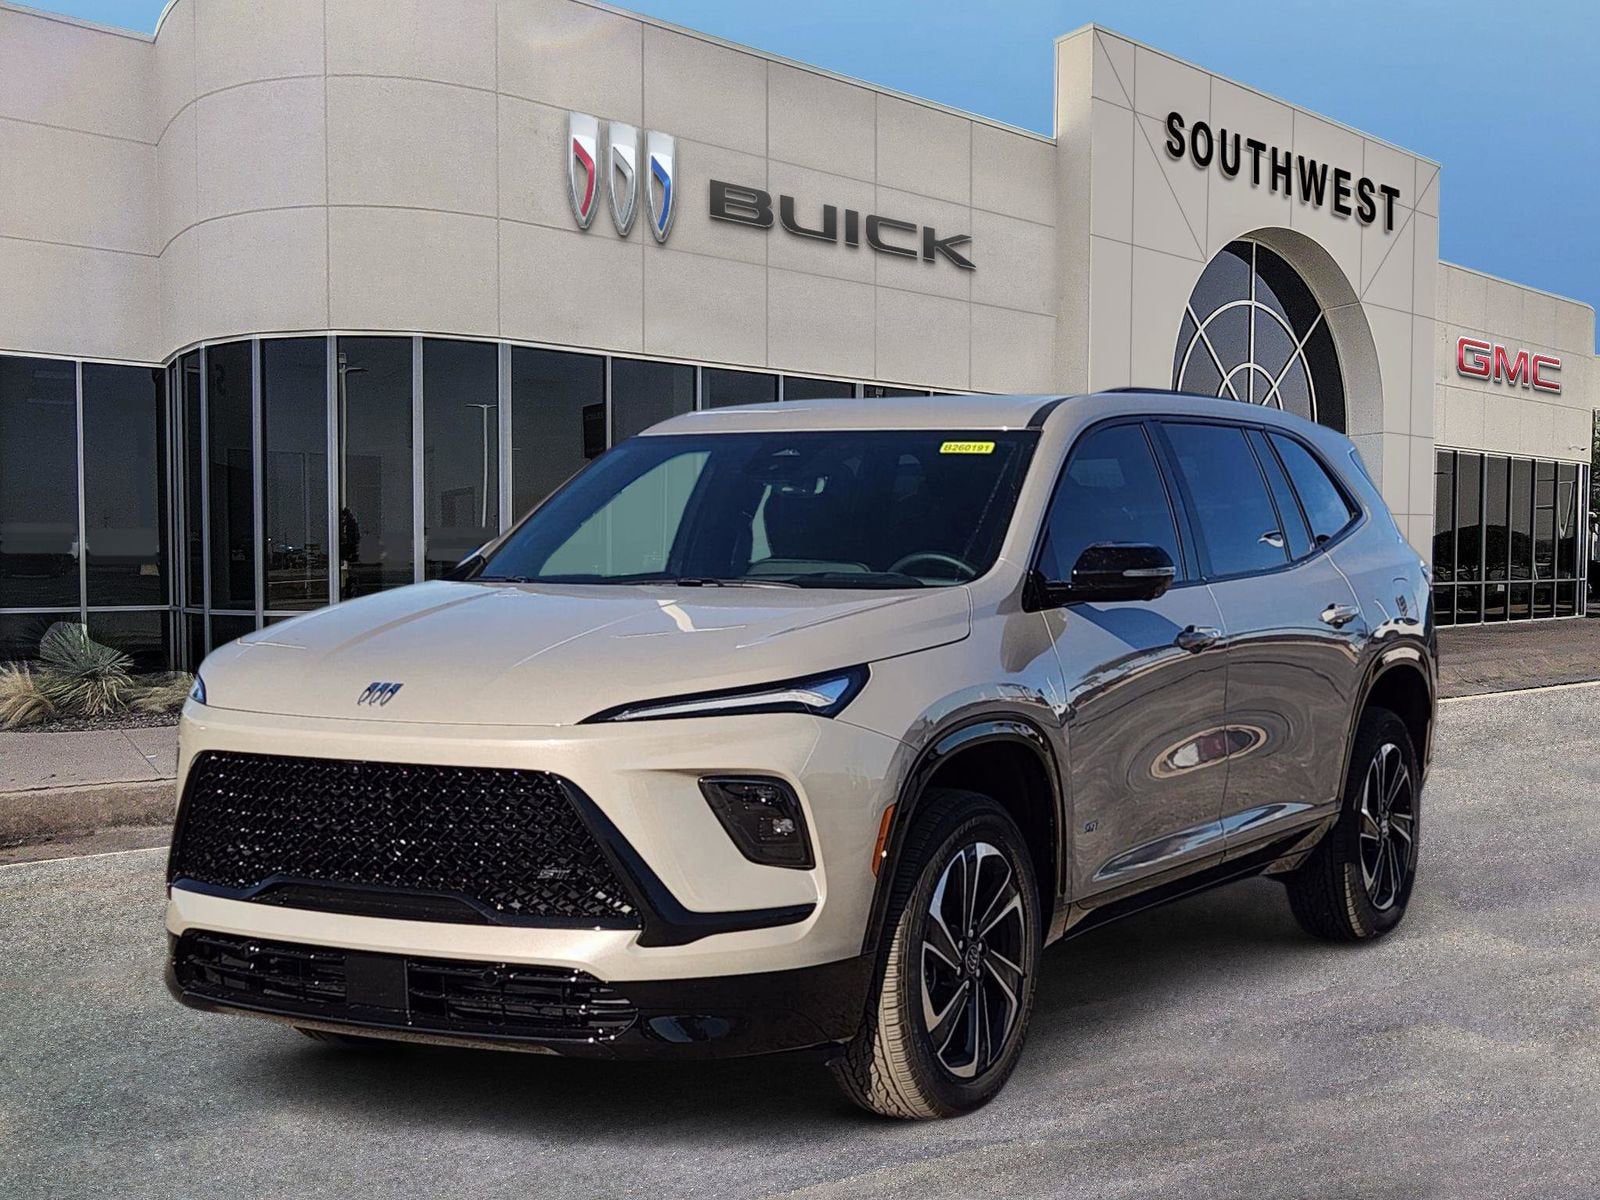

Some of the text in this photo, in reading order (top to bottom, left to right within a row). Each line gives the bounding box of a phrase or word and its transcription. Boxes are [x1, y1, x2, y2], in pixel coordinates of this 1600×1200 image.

[1165, 111, 1400, 232] SOUTHWEST
[709, 179, 976, 270] BUICK
[1457, 336, 1561, 394] GMC
[943, 443, 992, 452] B260191
